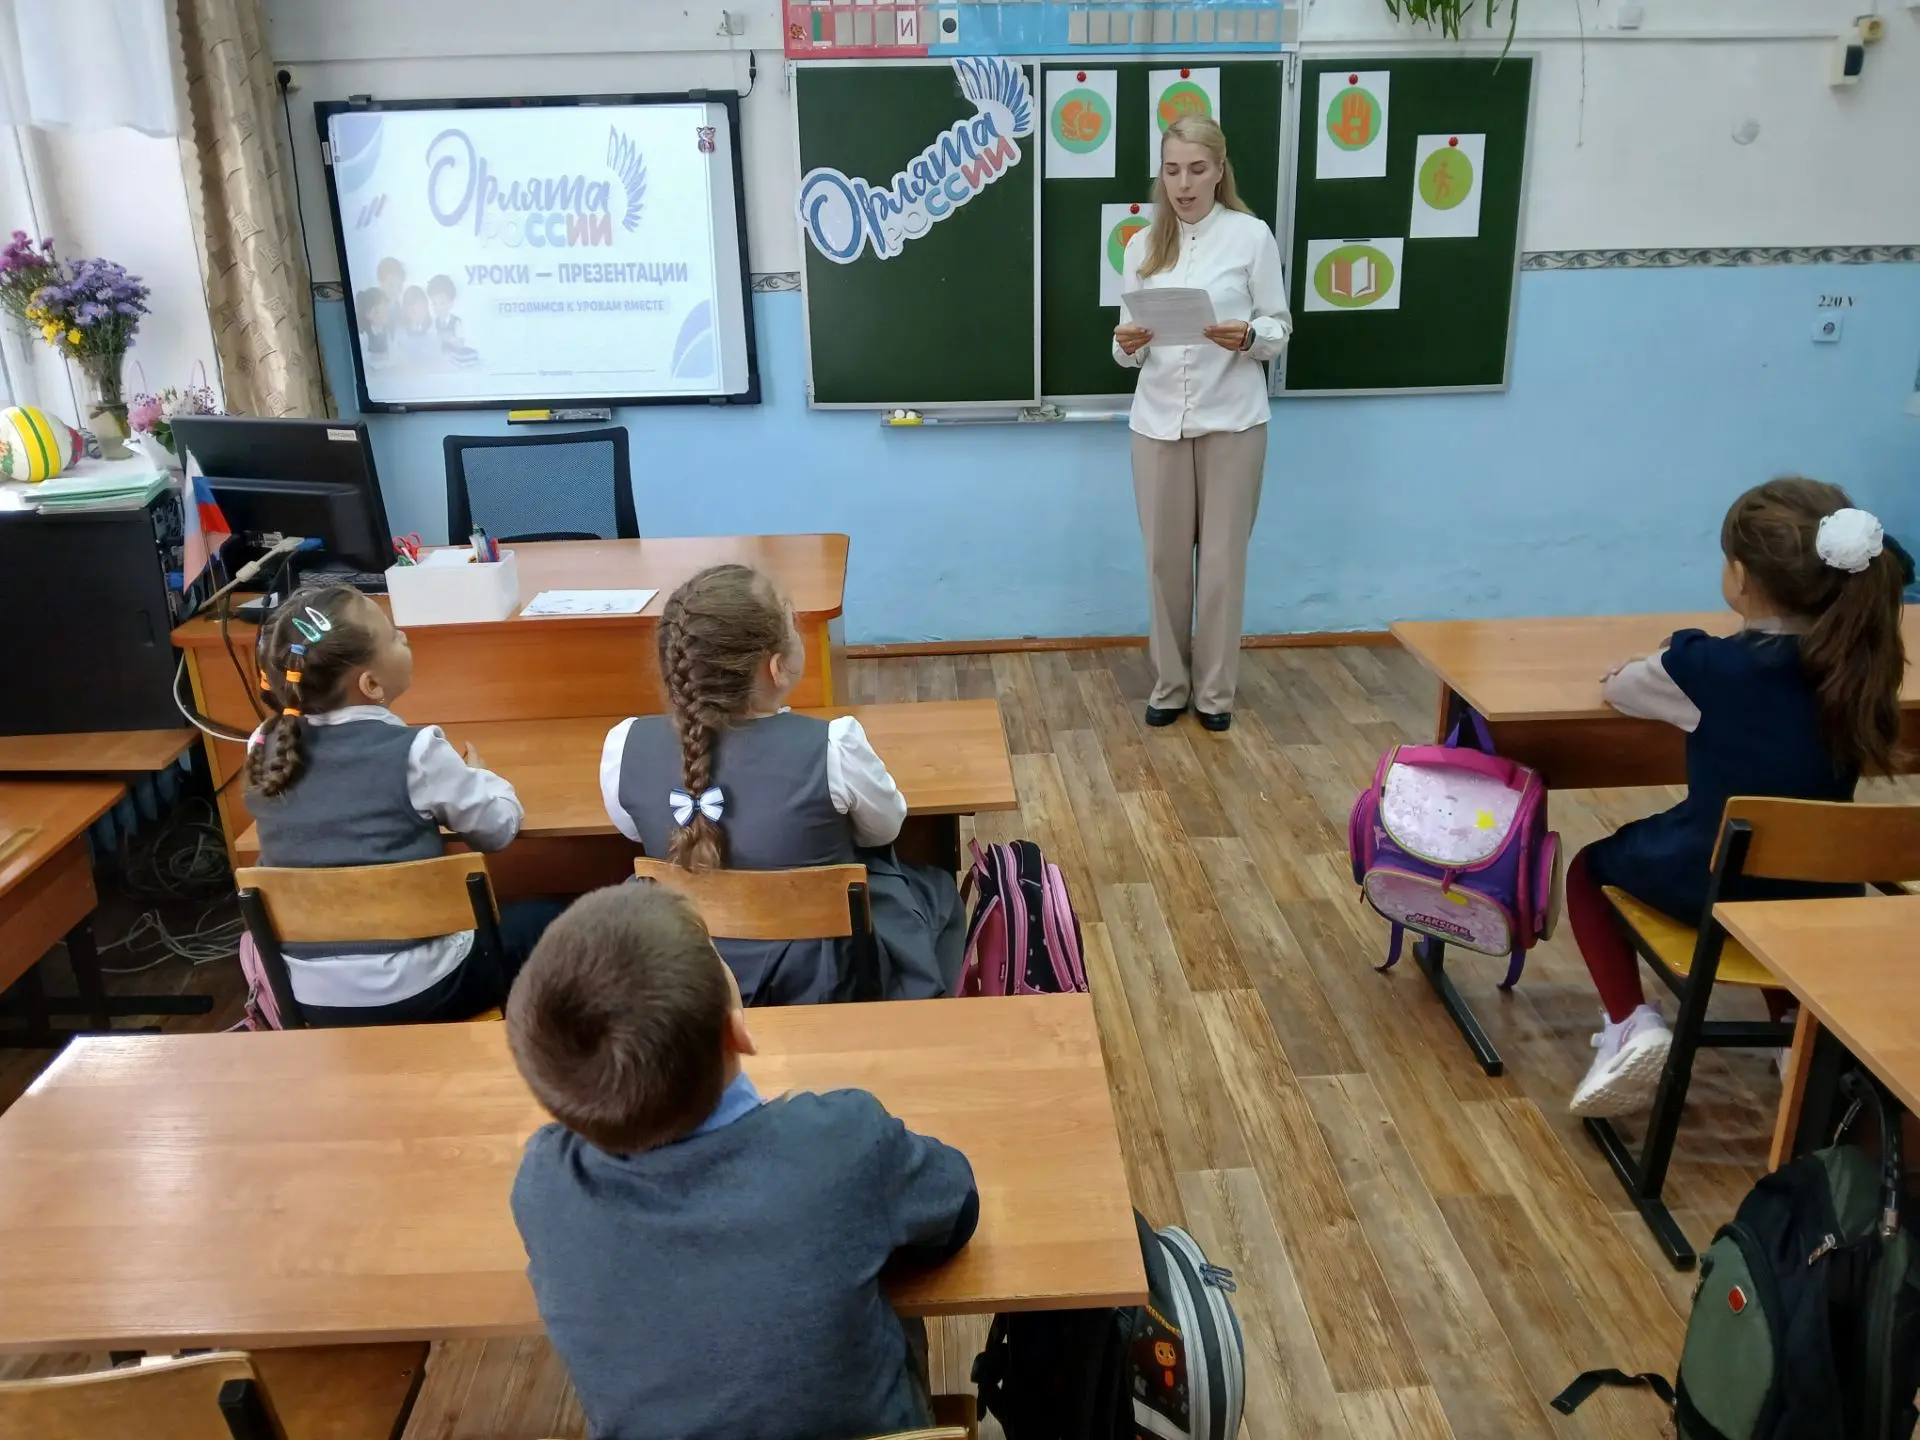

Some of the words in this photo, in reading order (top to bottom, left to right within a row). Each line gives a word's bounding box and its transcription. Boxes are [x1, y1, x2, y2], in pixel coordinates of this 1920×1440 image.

[900, 18, 914, 37] И
[425, 128, 611, 237] Орлята
[799, 112, 1000, 259] Орлята
[465, 264, 530, 286] УРОКИ
[558, 262, 688, 286] ПРЕЗЕНТАЦИИ
[498, 300, 564, 314] ГОТОВИМСЯ
[576, 300, 621, 313] УРОКАМ
[624, 299, 664, 312] ВМЕСТЕ
[1817, 294, 1843, 308] 220
